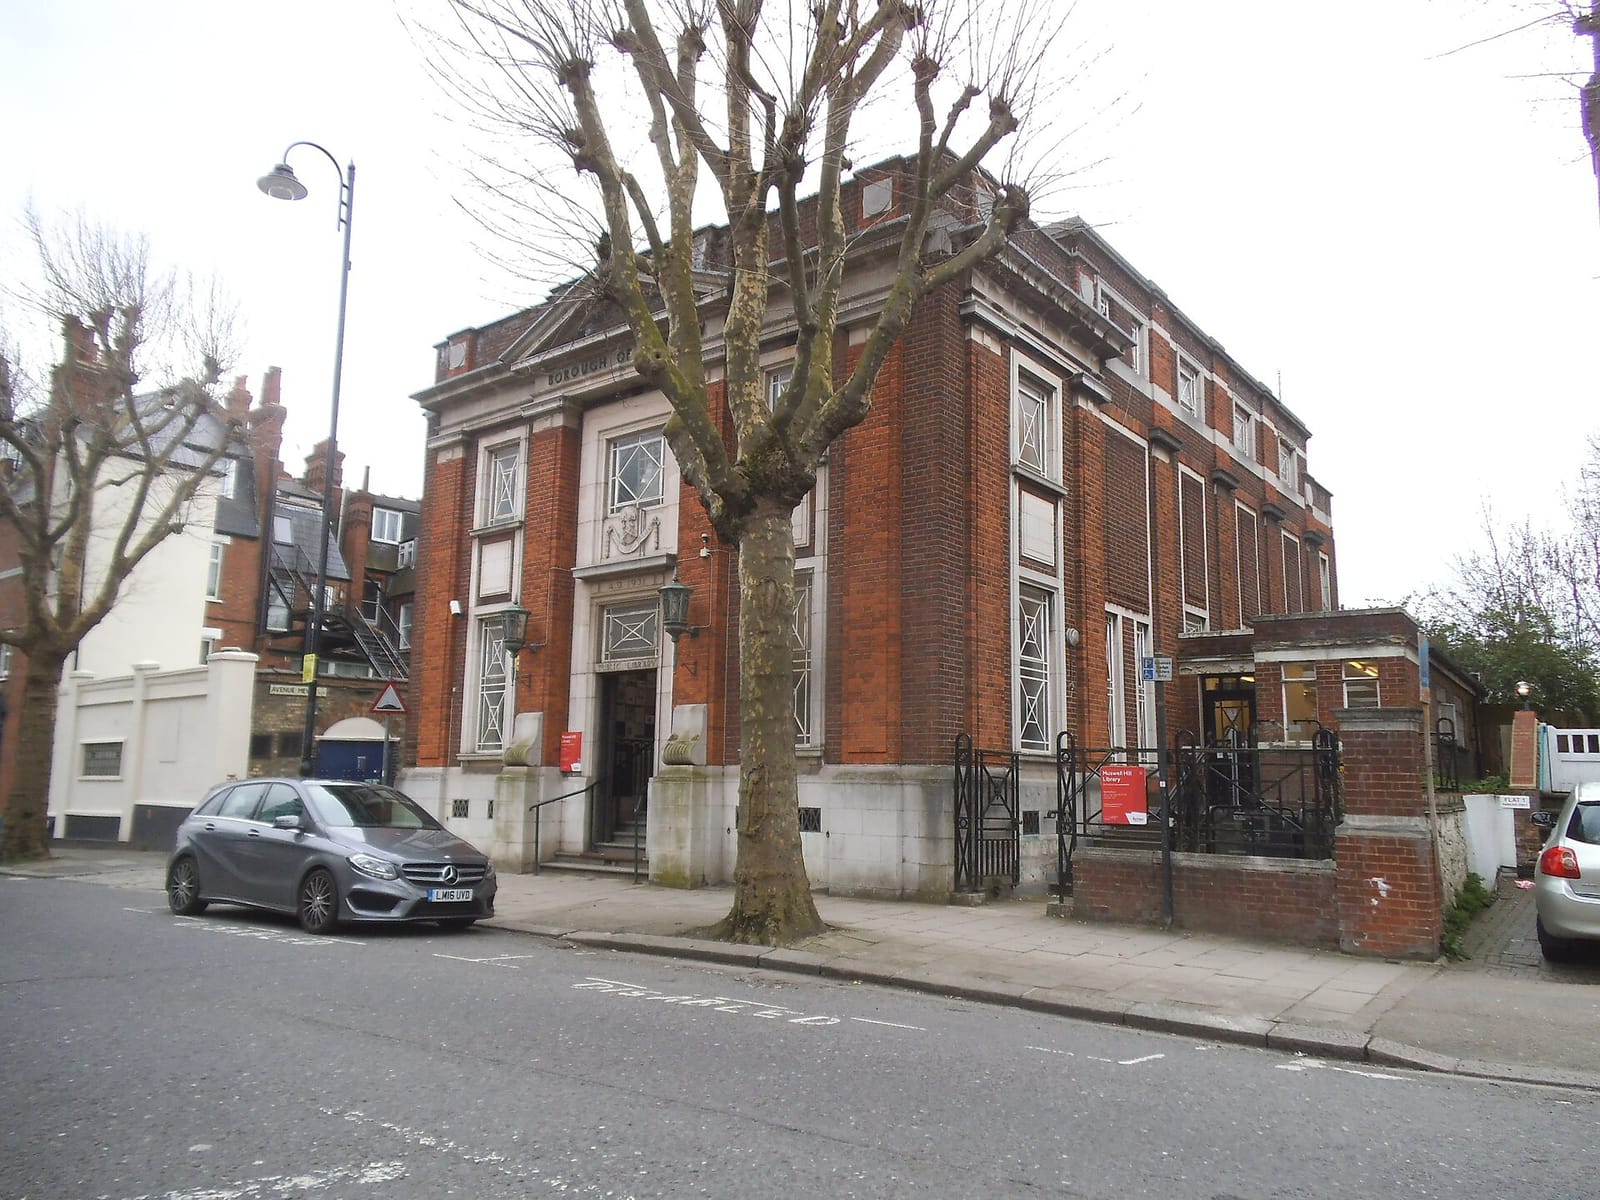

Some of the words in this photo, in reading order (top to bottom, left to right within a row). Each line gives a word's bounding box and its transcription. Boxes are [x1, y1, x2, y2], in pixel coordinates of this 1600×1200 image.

[548, 356, 607, 386] BOROUGH
[624, 659, 657, 670] LIBRARY
[271, 686, 295, 694] AVENUE
[436, 890, 455, 900] LM16
